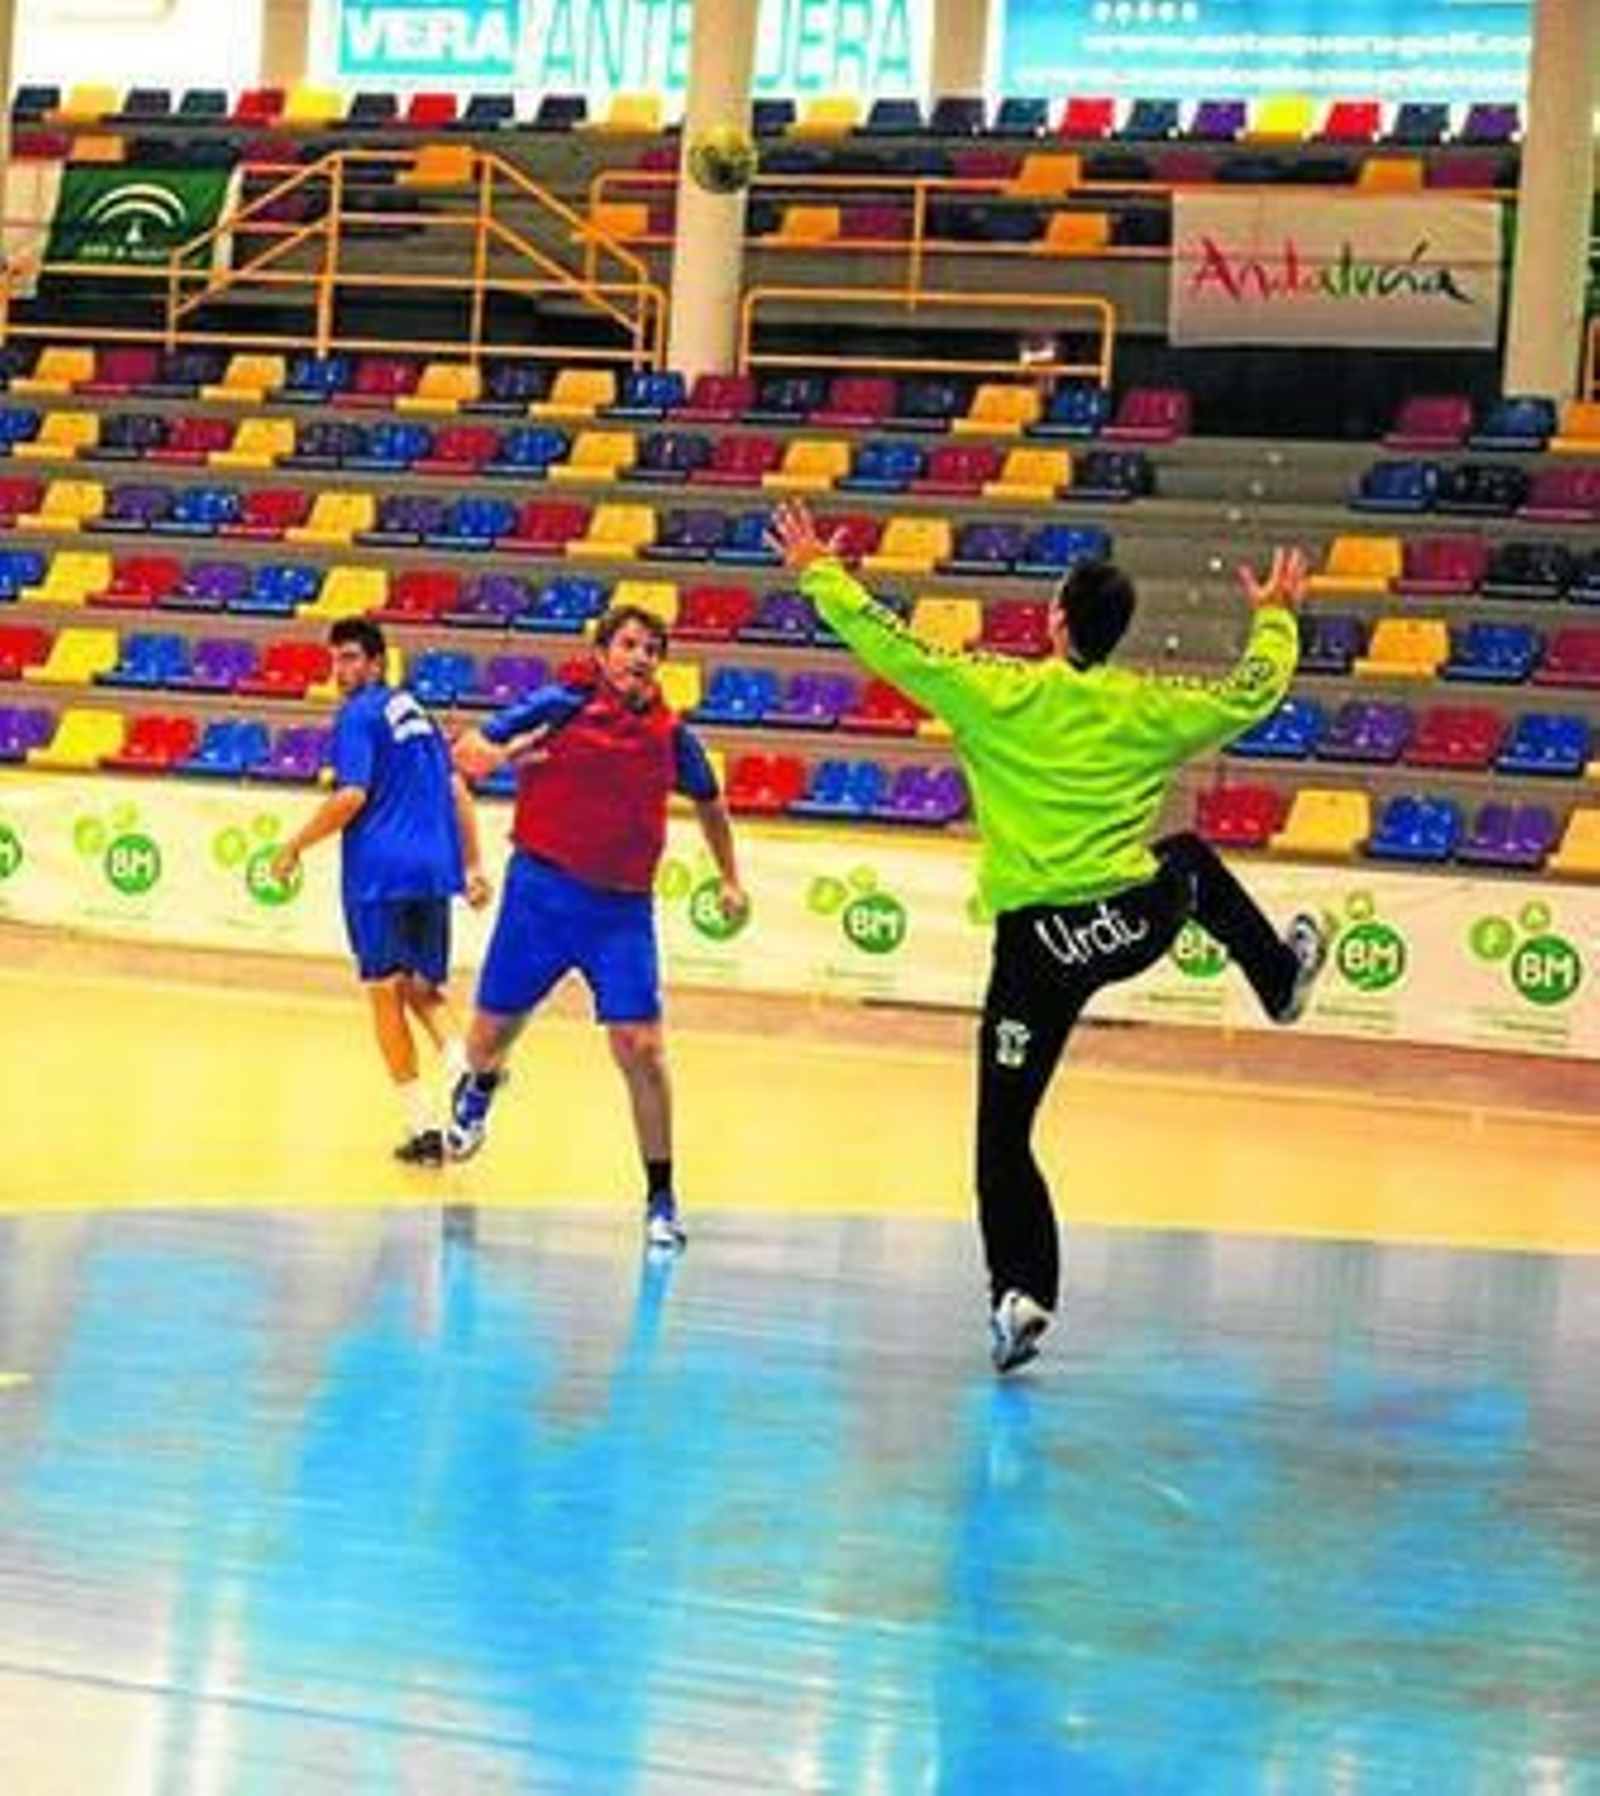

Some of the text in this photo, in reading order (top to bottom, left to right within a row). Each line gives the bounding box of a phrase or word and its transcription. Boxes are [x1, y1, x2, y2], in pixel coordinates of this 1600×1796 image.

[112, 848, 153, 878] BM
[851, 905, 898, 940] BM
[1344, 937, 1399, 976] BM
[1520, 951, 1576, 990] BM
